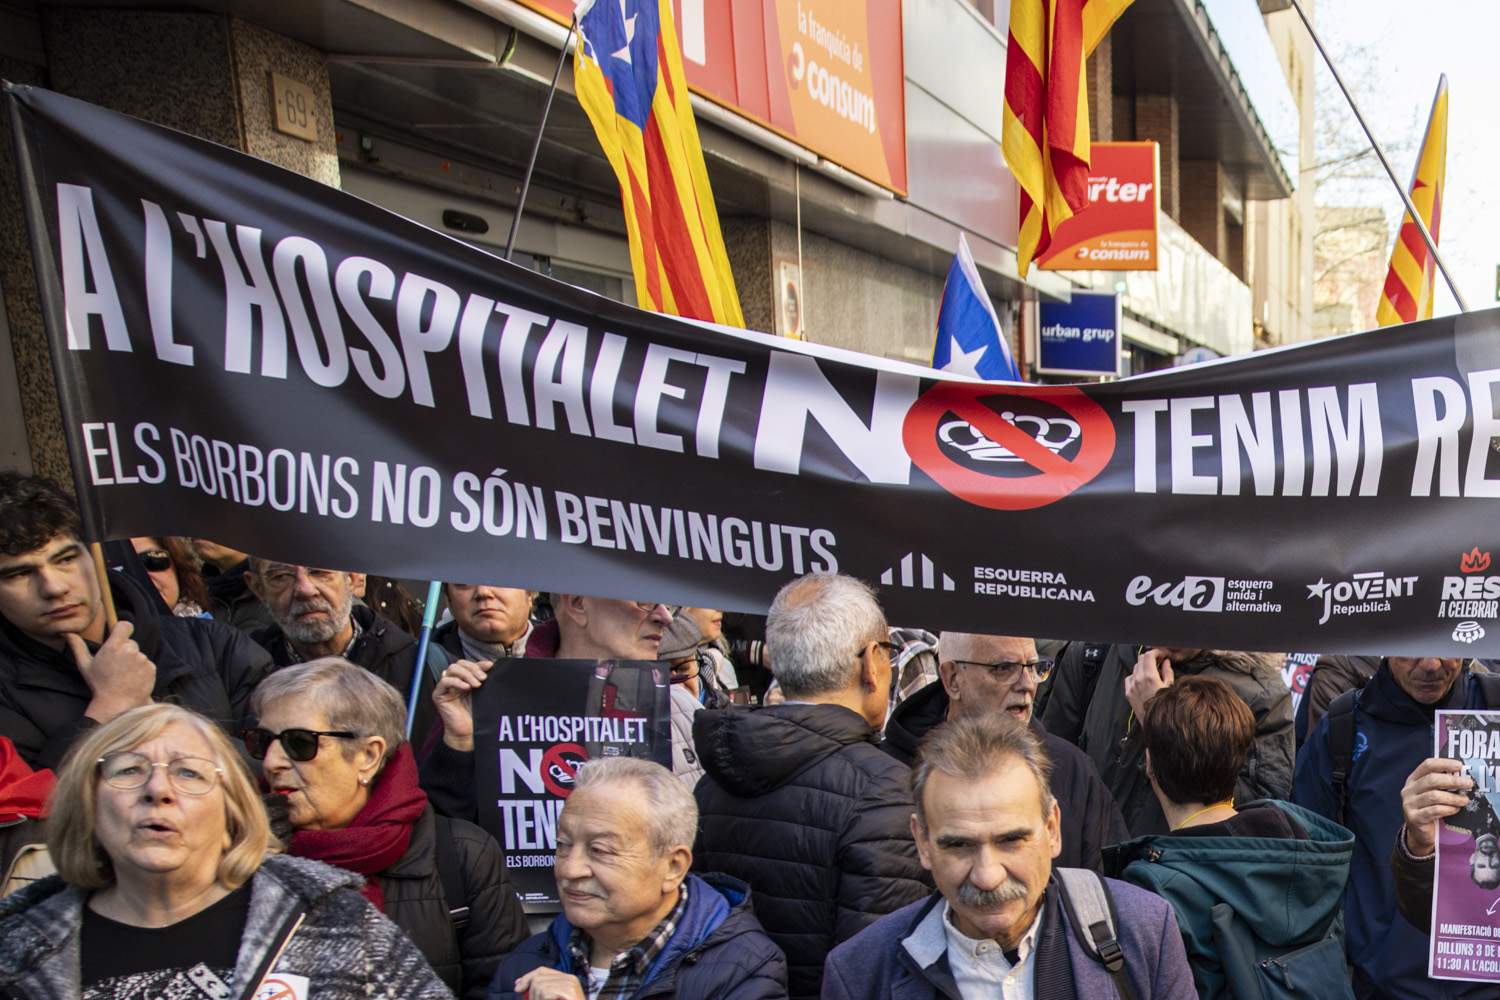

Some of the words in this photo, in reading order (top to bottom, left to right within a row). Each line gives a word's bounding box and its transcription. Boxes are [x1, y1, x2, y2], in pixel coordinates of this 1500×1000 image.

[808, 10, 850, 65] franquicia
[852, 42, 863, 72] de
[807, 60, 876, 134] consum
[285, 89, 307, 128] 69
[1088, 177, 1153, 203] rter
[1090, 248, 1150, 260] consum
[57, 182, 133, 353] A
[140, 198, 747, 460] L'HOSPITALET
[1122, 382, 1384, 497] TENIM
[1042, 323, 1080, 338] urban
[1082, 327, 1115, 343] grup
[82, 421, 166, 486] ELS
[170, 427, 359, 519] BORBONS
[371, 460, 441, 528] NO
[450, 468, 547, 541] SÓN
[555, 490, 839, 577] BENVINGUTS
[973, 566, 1067, 586] ESQUERRA
[1227, 579, 1273, 591] esquerra
[973, 582, 1095, 602] REPUBLICANA
[1227, 589, 1256, 601] unida
[1258, 590, 1263, 600] i
[1226, 601, 1282, 613] alternativa
[1333, 600, 1391, 616] Republicà
[1438, 601, 1447, 618] A
[1448, 600, 1499, 618] CELEBRAR
[499, 715, 513, 742] A
[517, 715, 648, 743] L'HOSPITALET
[1447, 729, 1500, 760] FORA
[498, 799, 565, 850] TEN
[506, 855, 522, 868] ELS
[523, 855, 557, 868] BORBON
[1440, 923, 1492, 938] MANIFESTACIÓ
[1437, 941, 1475, 956] DILLUNS
[1476, 944, 1483, 957] 3
[1484, 944, 1496, 958] DE
[1436, 957, 1462, 971] 11:30
[1463, 959, 1470, 971] A
